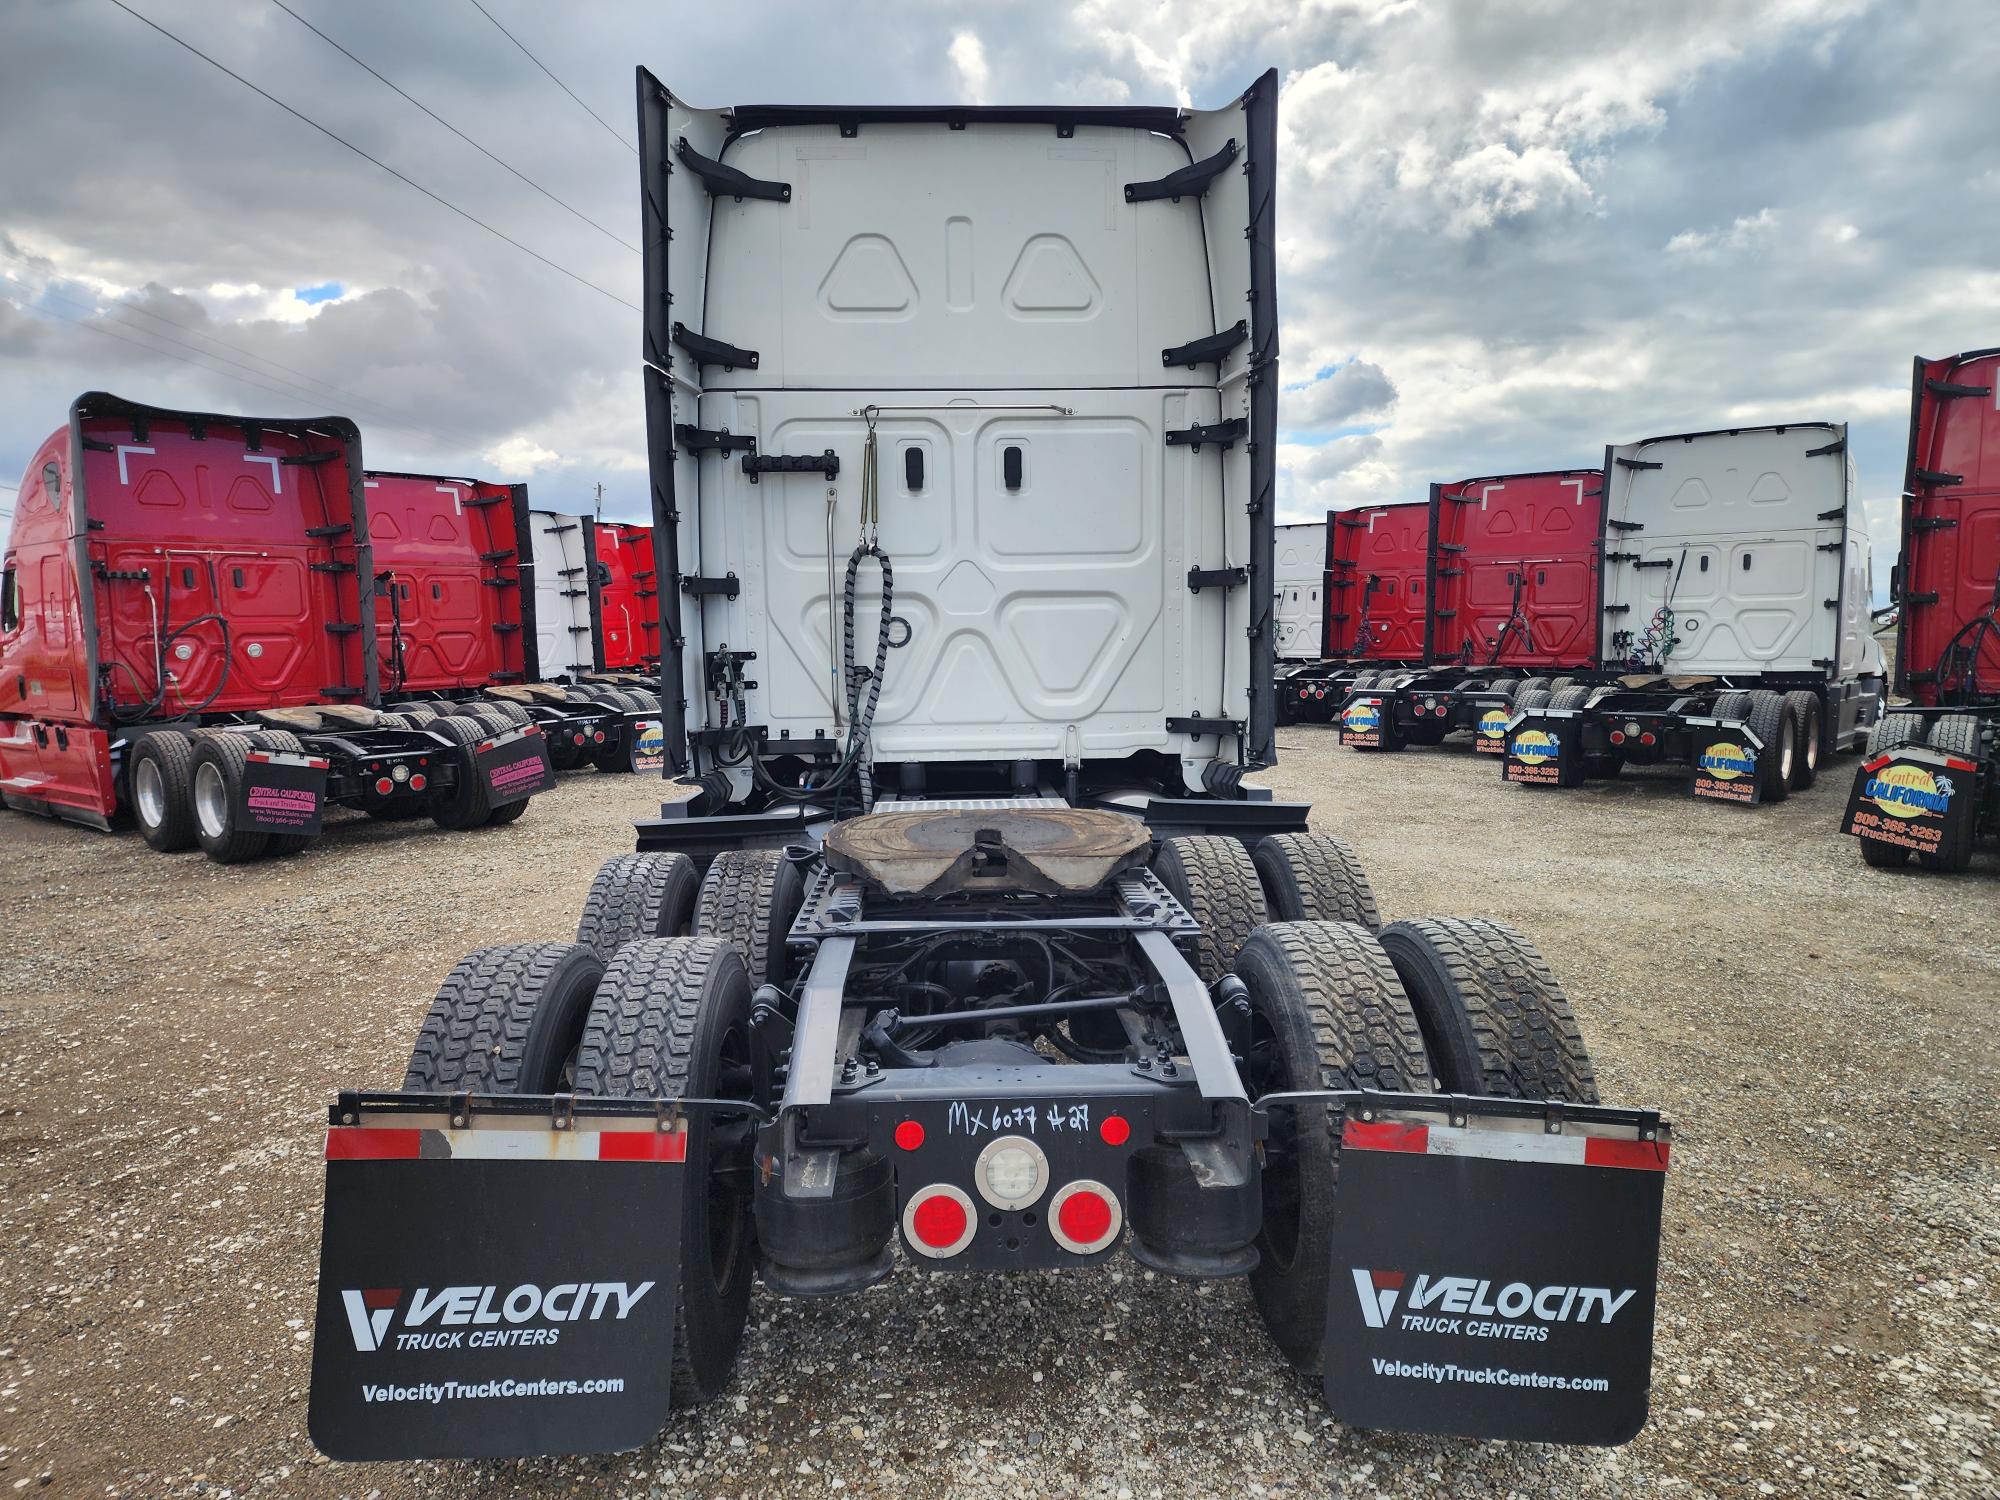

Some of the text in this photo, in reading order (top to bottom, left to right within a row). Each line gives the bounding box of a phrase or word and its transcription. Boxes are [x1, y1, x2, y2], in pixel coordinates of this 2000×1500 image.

[1511, 743, 1559, 757] CALIFORNIA
[1700, 754, 1755, 773] CALIFORNIA
[1695, 779, 1754, 794] 800-366-3263
[1877, 768, 1934, 787] Central
[250, 786, 316, 802] CENTRAL CALIFORNIA
[1865, 778, 1950, 813] CALIFORNIA
[1851, 823, 1938, 854] WTruckSales.net
[1853, 811, 1943, 842] 800-366-3263
[404, 1281, 656, 1327] VELOCITY
[1408, 1273, 1637, 1325] VELOCITY
[395, 1328, 560, 1351] TRUCK CENTERS
[1401, 1314, 1549, 1342] TRUCK CENTERS
[1372, 1358, 1609, 1392] VelocityTruckCenters.com
[362, 1377, 625, 1404] VelocityTruckCenters.com
